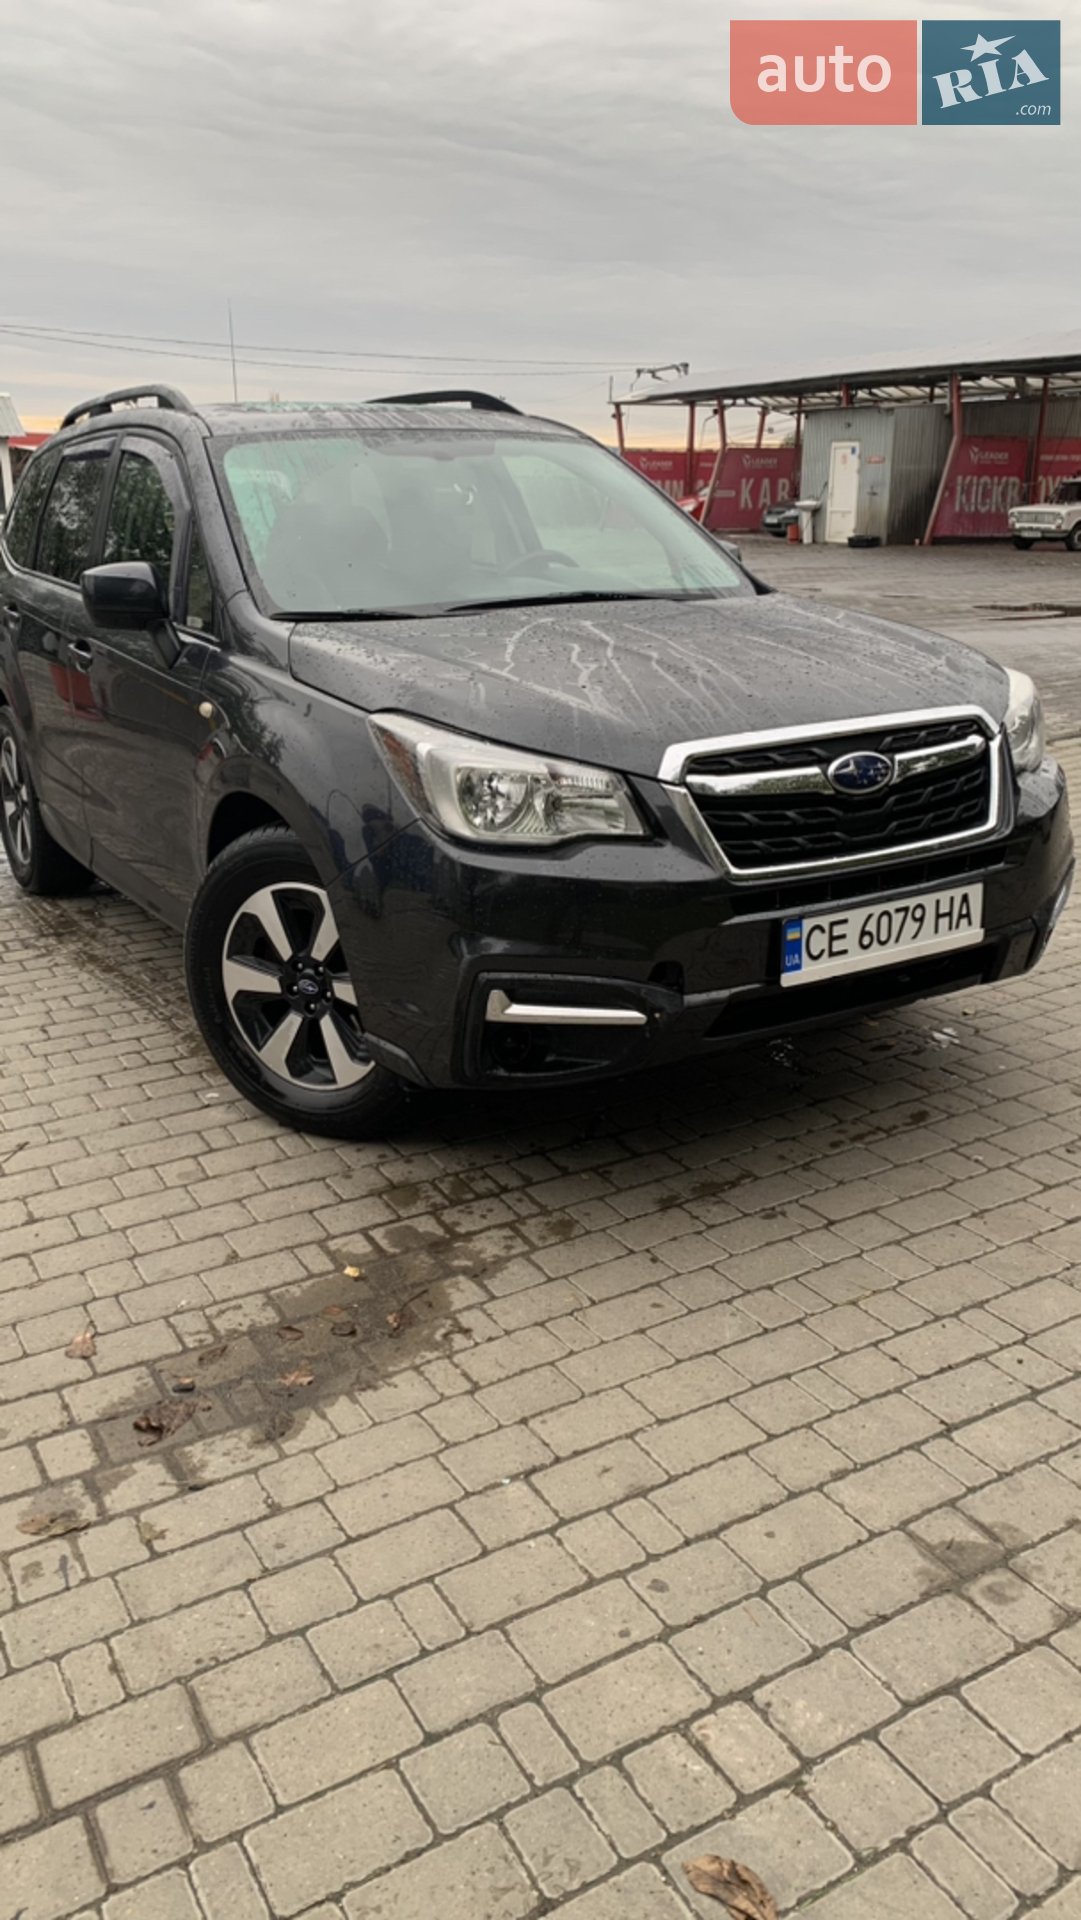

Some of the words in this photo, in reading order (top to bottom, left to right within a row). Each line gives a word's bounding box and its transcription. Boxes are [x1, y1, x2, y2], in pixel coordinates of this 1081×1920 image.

[805, 918, 849, 961] CE
[858, 903, 926, 950] 6079
[934, 892, 972, 935] HA
[785, 953, 801, 967] UA
